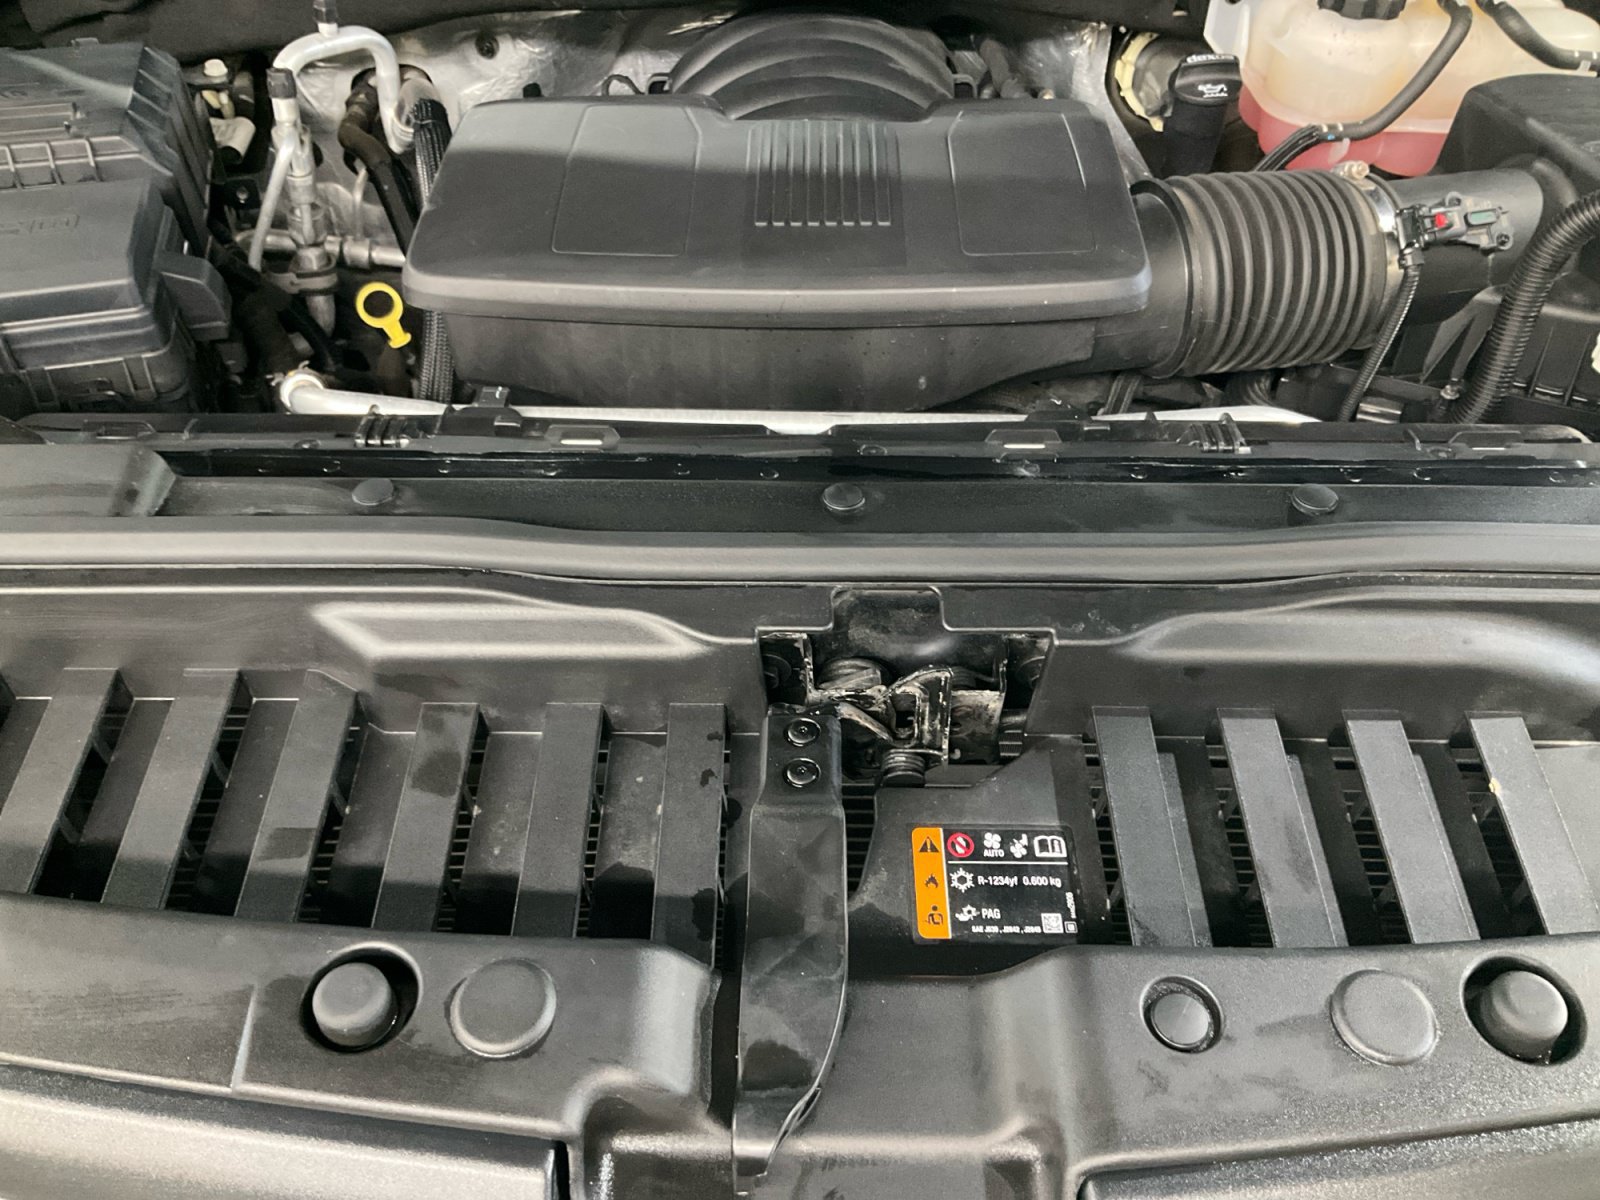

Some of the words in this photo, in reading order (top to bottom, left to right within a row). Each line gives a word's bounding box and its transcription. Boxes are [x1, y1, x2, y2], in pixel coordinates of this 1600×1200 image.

[983, 848, 1005, 858] AUTO
[977, 875, 1018, 887] R-1234yf
[1022, 876, 1048, 886] 0.600
[1049, 876, 1062, 888] kg
[981, 908, 1001, 919] PAG
